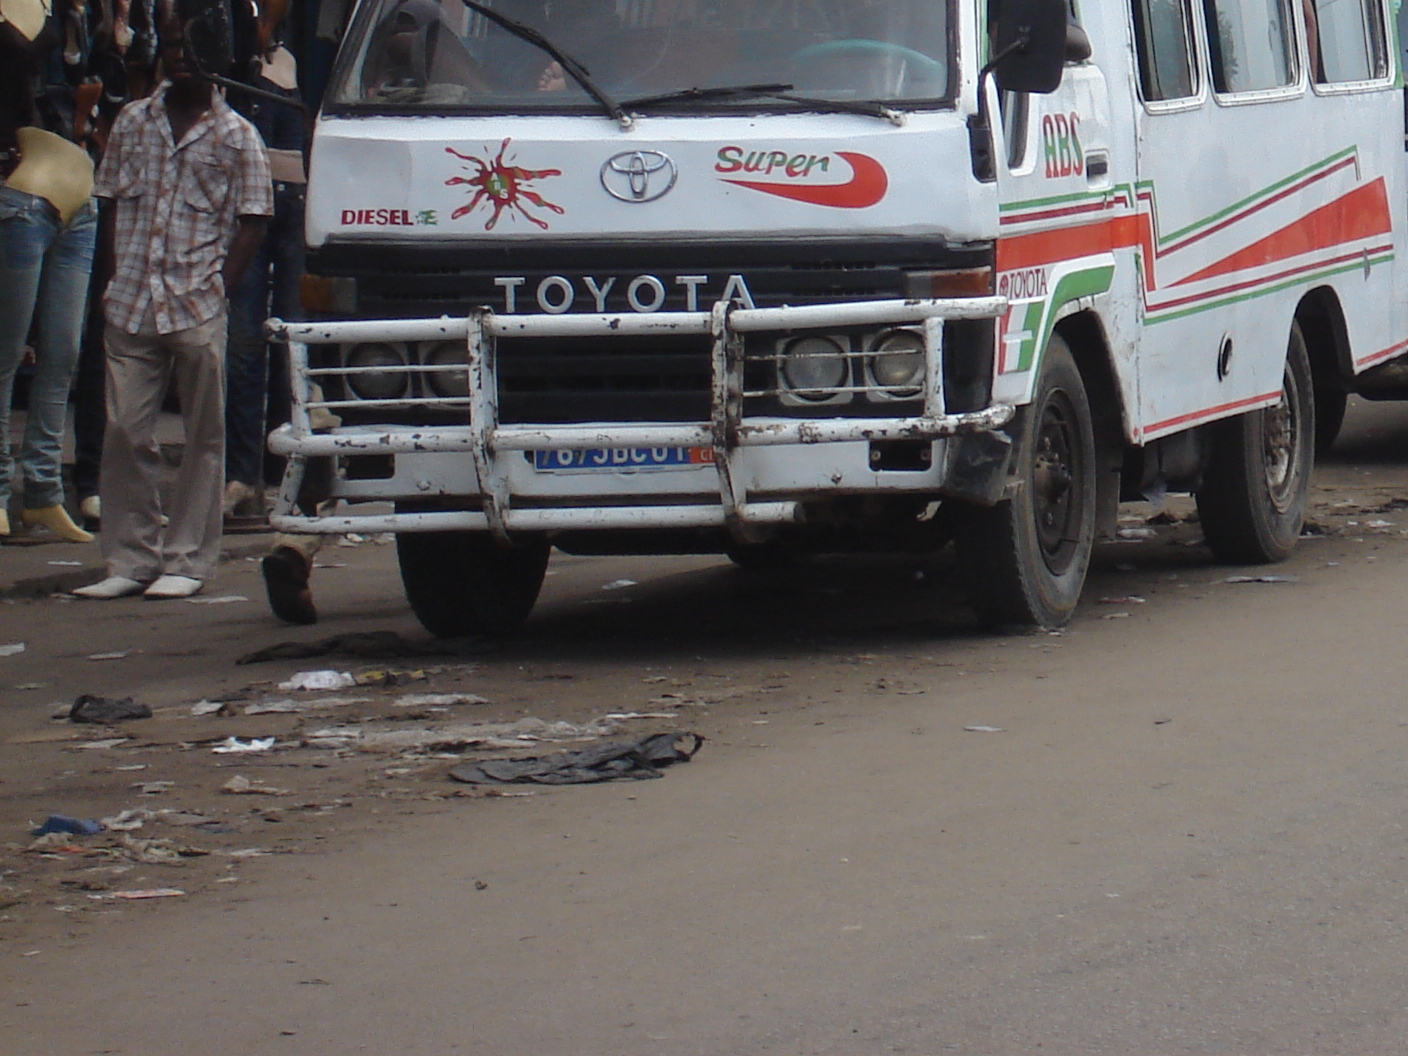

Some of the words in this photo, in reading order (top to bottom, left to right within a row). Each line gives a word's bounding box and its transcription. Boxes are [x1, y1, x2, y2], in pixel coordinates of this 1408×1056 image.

[715, 145, 830, 178] Super
[1042, 112, 1084, 179] ABS
[494, 274, 757, 315] TOYOTA
[1008, 268, 1048, 299] TOYOTA
